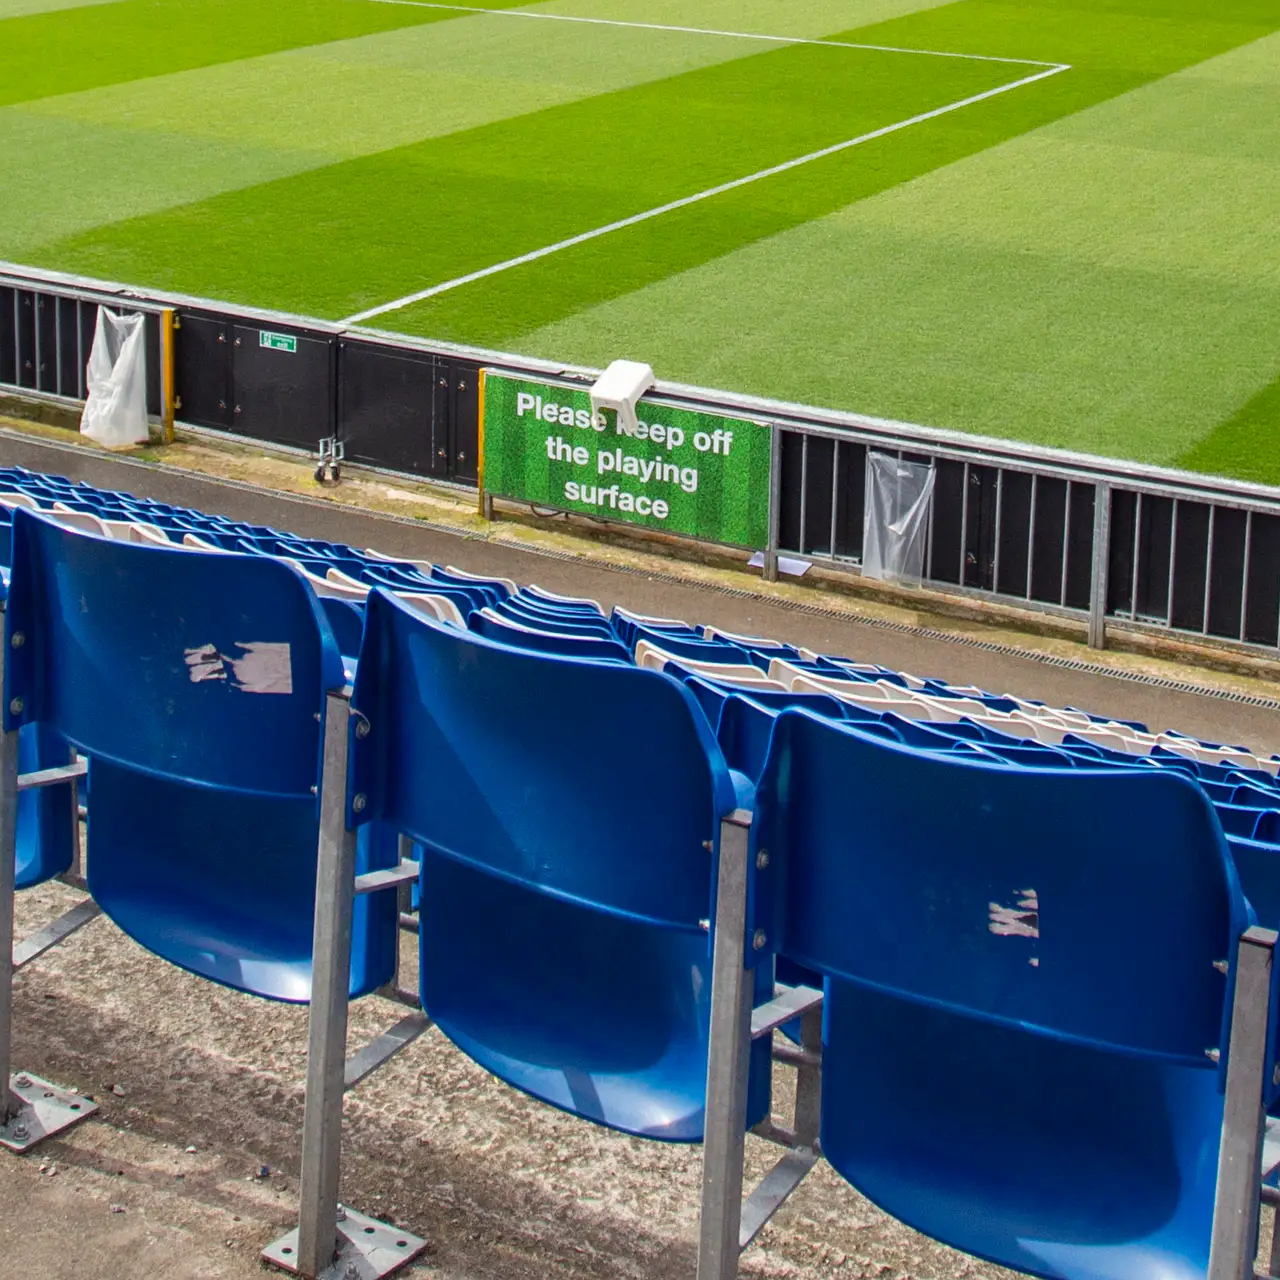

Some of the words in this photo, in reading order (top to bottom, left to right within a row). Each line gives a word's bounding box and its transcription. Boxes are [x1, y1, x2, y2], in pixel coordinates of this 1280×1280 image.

[516, 391, 607, 432] Please
[693, 428, 733, 456] off
[545, 435, 590, 465] the
[598, 448, 698, 493] playing
[564, 480, 669, 519] surface
